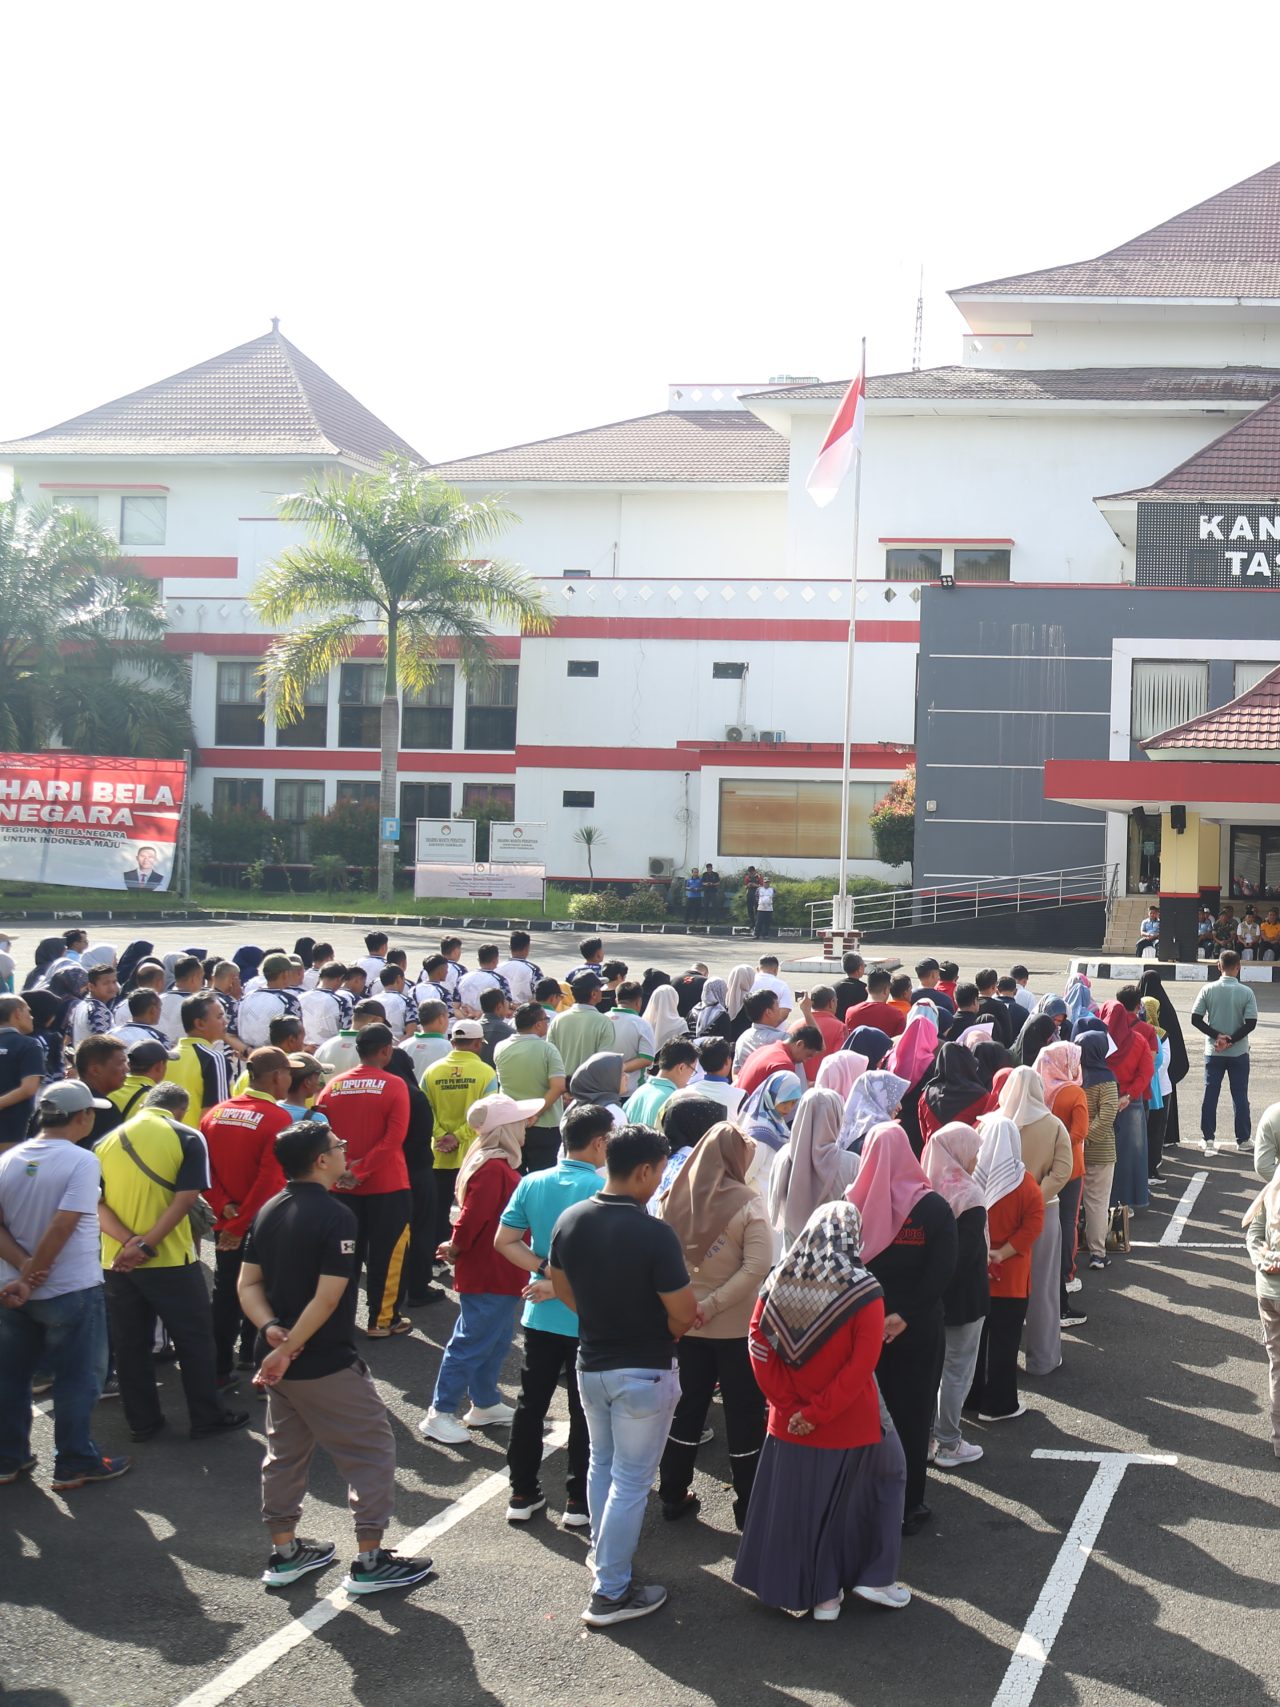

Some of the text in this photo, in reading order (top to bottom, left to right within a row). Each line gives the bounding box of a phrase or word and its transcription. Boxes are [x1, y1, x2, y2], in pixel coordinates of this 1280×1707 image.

[0, 779, 174, 806] HARI BELA
[0, 803, 134, 826] NEGARA
[3, 836, 37, 844] UNTUK
[94, 840, 121, 849] MAJU
[57, 828, 83, 837] BELA
[85, 830, 126, 839] NEGARA
